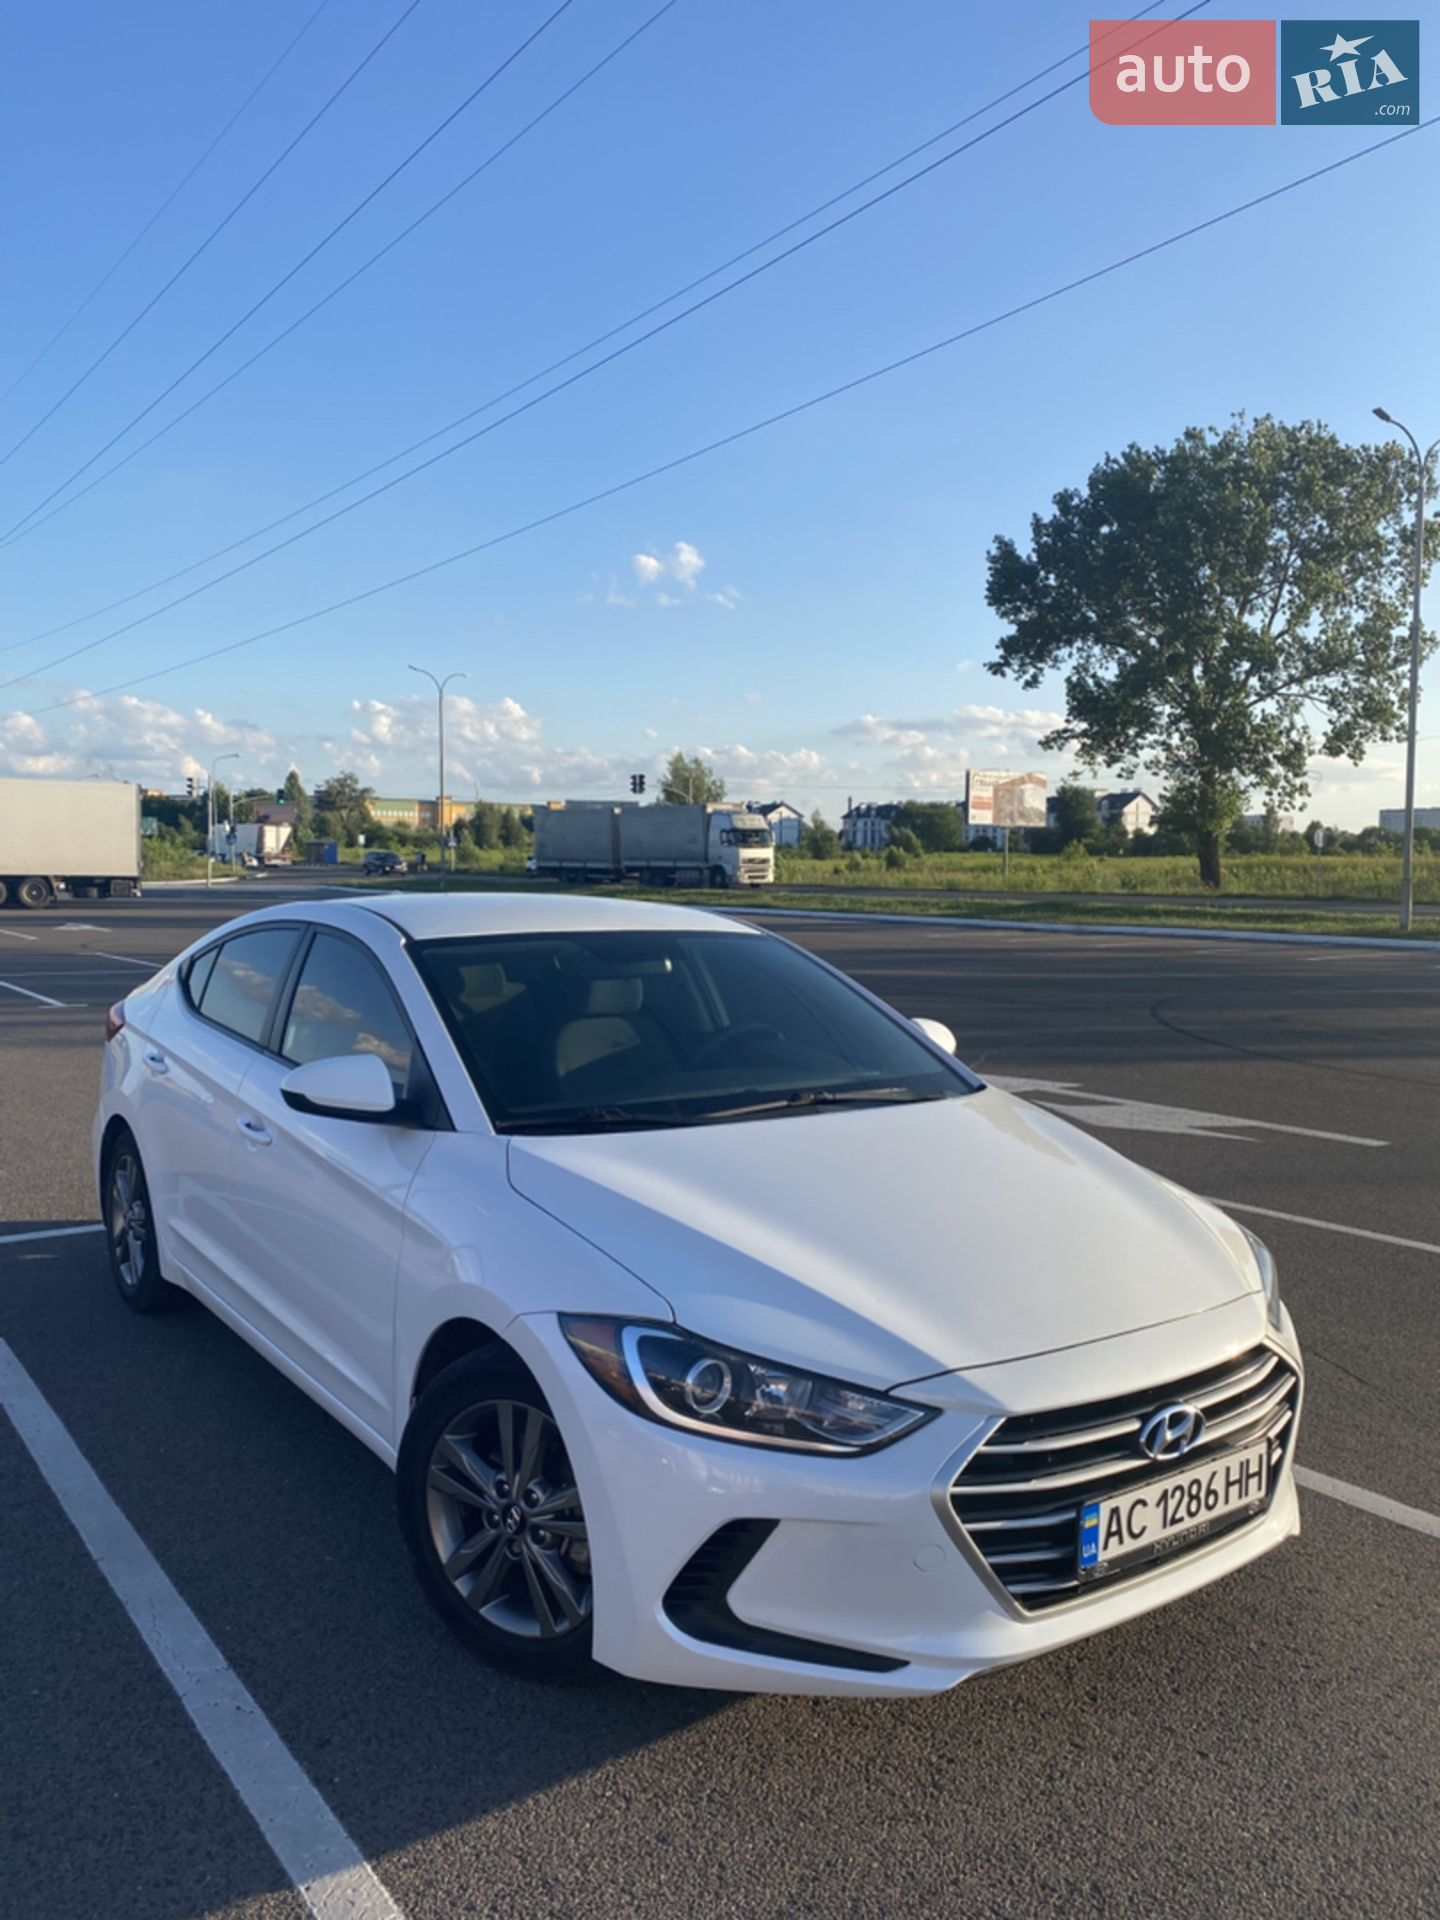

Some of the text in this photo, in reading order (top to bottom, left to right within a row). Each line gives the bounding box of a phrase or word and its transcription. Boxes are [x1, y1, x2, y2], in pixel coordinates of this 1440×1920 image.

[1103, 1453, 1264, 1550] AC 1286 HH
[1082, 1542, 1097, 1558] UA
